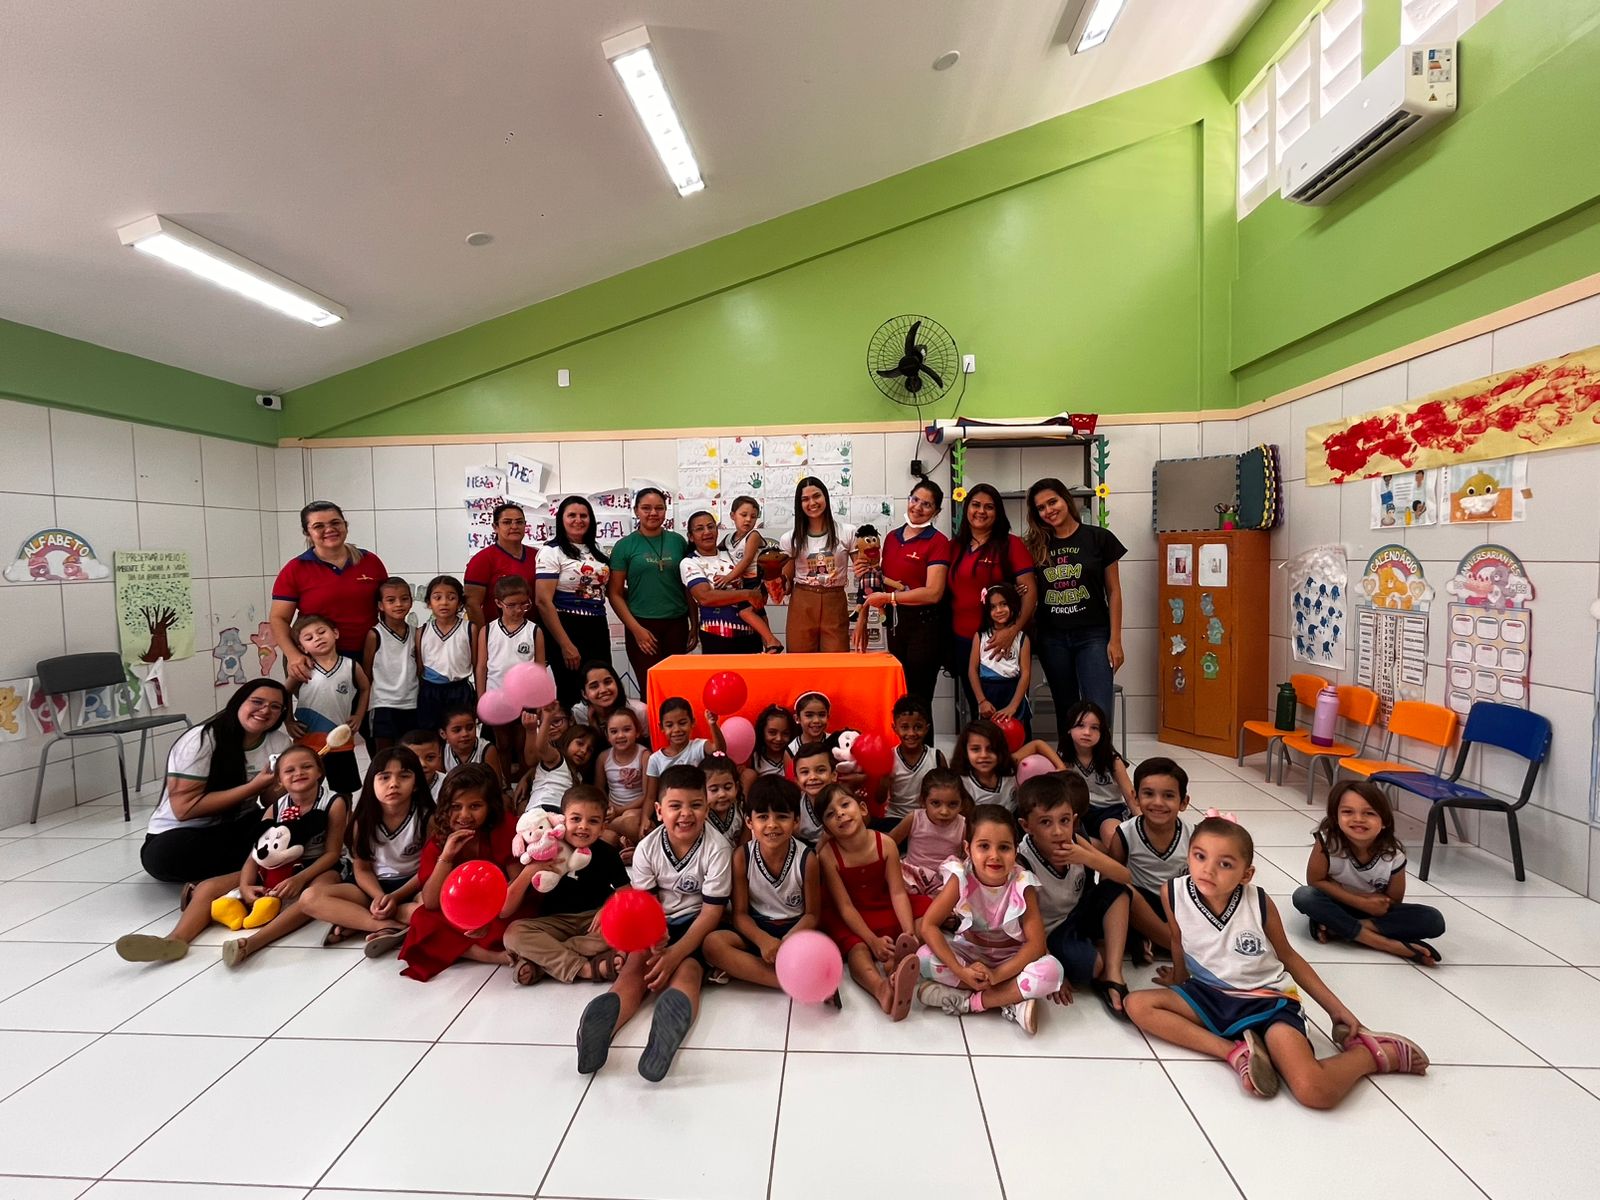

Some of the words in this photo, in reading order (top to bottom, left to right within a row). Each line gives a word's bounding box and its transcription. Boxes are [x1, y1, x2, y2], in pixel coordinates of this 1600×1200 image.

[596, 520, 624, 538] GAEL
[24, 534, 90, 558] ALFABETO
[1058, 547, 1080, 555] ESTOU
[1057, 556, 1068, 564] DE
[1370, 550, 1418, 574] CALENDÁRIO
[1460, 550, 1522, 576] ANIVERSARIANTES
[1044, 563, 1082, 582] BEM
[1045, 585, 1090, 605] ENEM
[1510, 581, 1528, 594] MÊS
